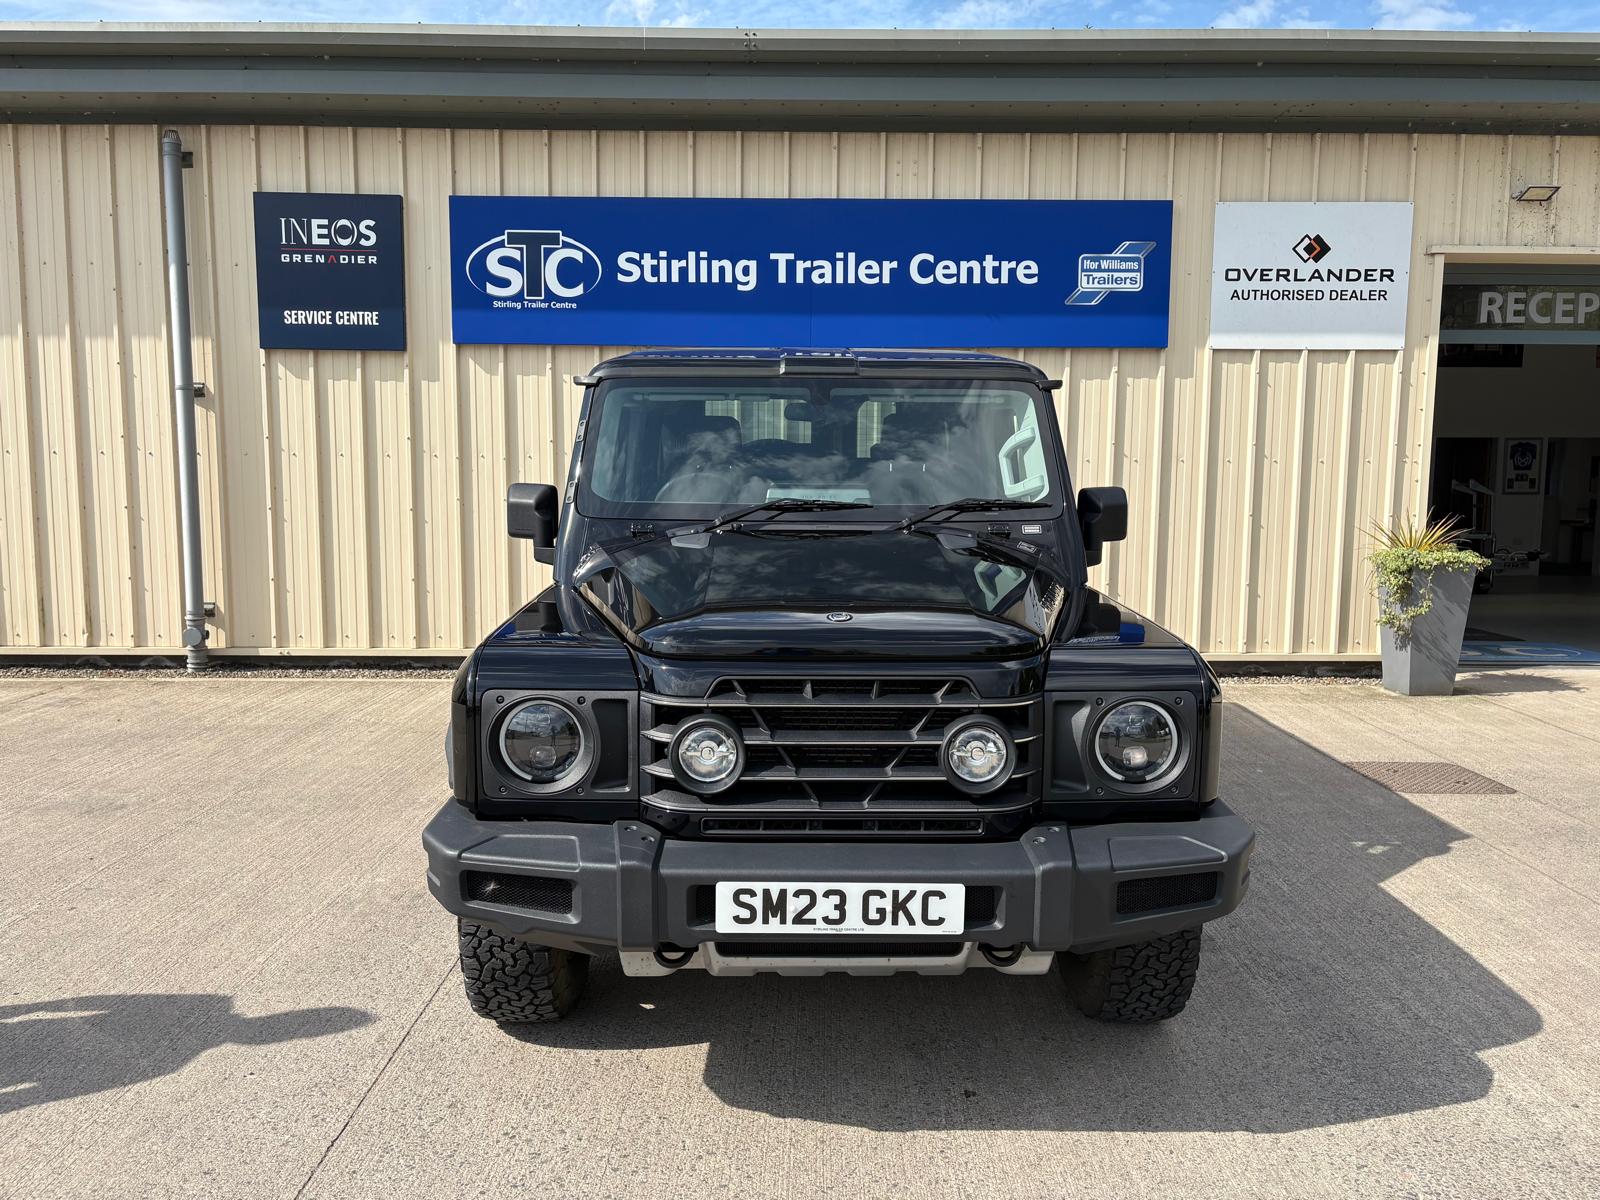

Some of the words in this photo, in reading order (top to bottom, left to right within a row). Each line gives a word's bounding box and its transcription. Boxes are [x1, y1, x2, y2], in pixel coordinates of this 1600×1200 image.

[280, 217, 377, 247] INEOS
[281, 253, 378, 265] GRENADIER
[486, 229, 585, 300] STC
[1083, 259, 1099, 270] Ifor
[1101, 259, 1139, 270] Williams
[616, 250, 757, 291] Stirling
[770, 252, 898, 284] Trailer
[909, 252, 1039, 285] Centre
[1224, 268, 1395, 283] OVERLANDER
[1083, 273, 1139, 286] Trailers
[1230, 289, 1325, 301] AUTHORISED
[1329, 289, 1388, 302] DEALER
[493, 300, 521, 309] Stirling
[523, 301, 549, 309] Trailer
[551, 301, 577, 309] Centre
[283, 310, 332, 325] SERVICE
[335, 310, 379, 326] CENTRE
[732, 887, 847, 926] SM23
[861, 889, 947, 927] GKC
